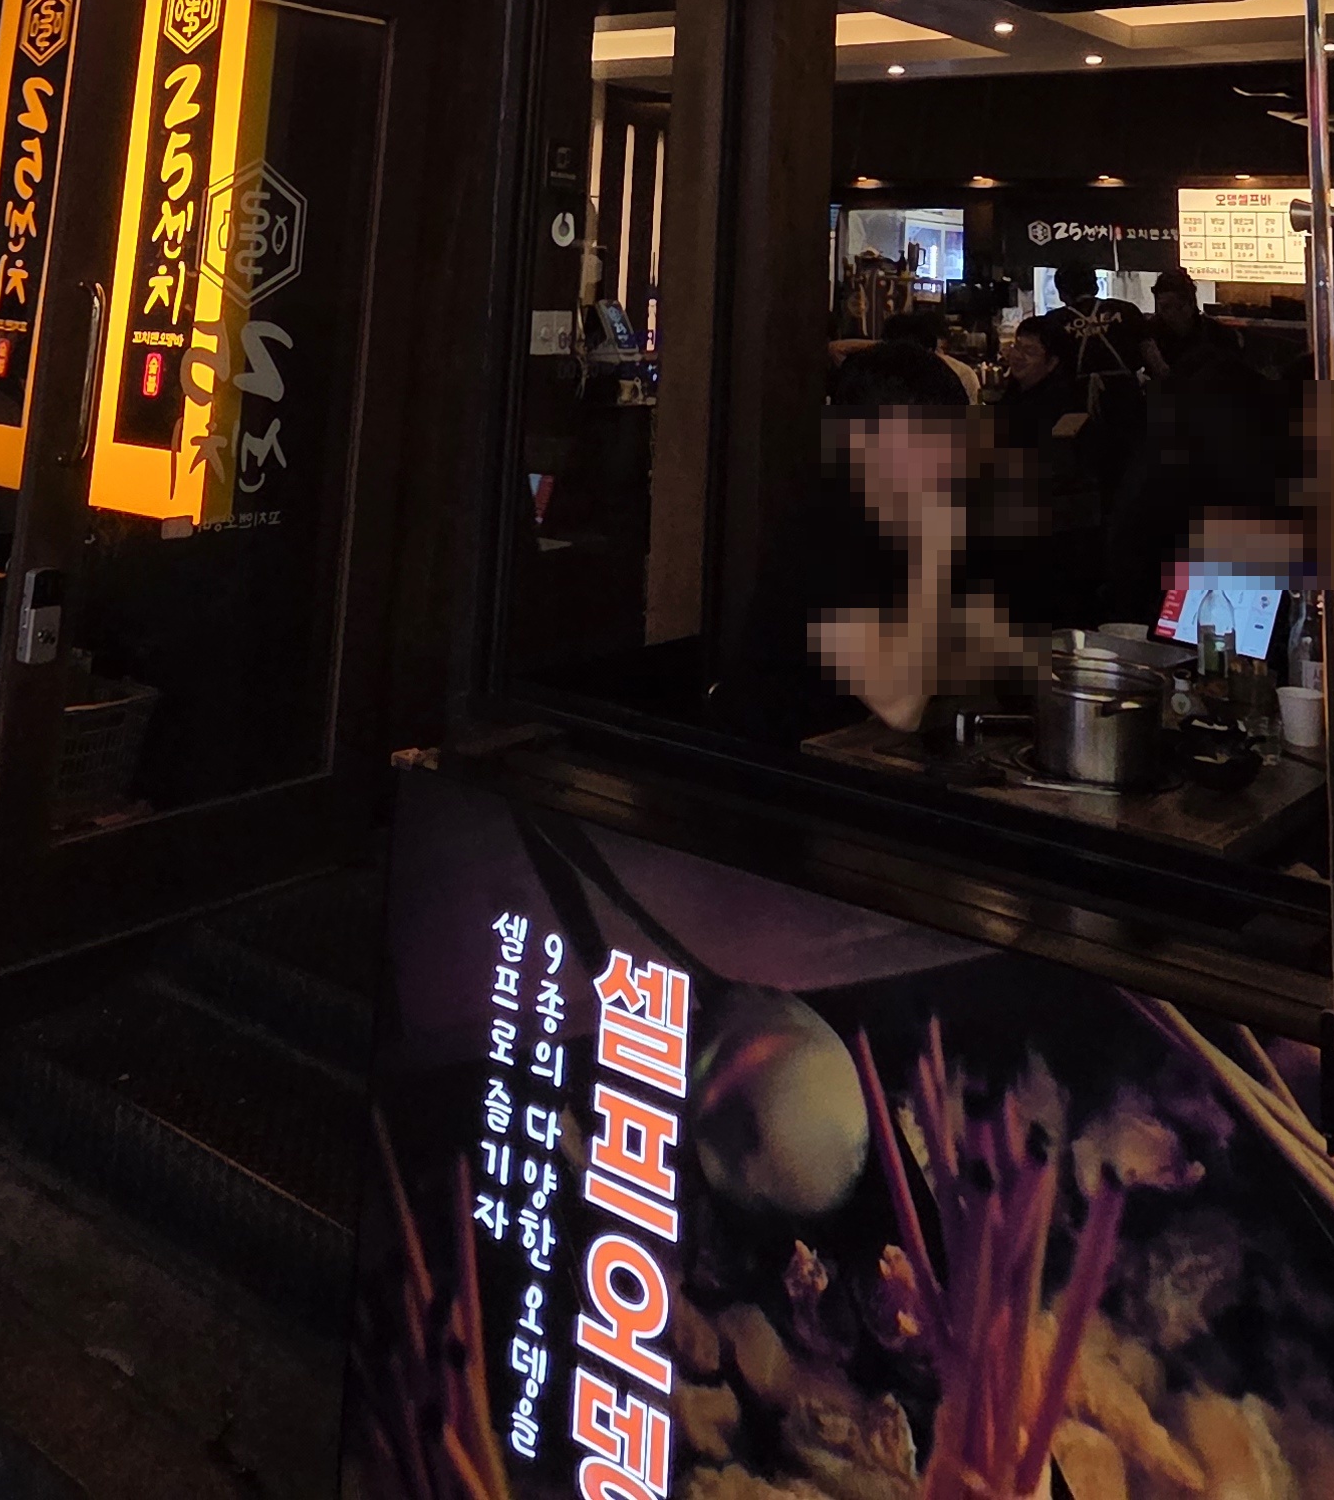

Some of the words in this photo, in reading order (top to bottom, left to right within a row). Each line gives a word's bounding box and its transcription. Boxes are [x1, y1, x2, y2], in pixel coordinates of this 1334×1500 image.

[491, 911, 528, 1066] 셀프로
[531, 933, 565, 1088] 9종의
[473, 1078, 513, 1241] 즐기자
[517, 1103, 563, 1272] 다양한
